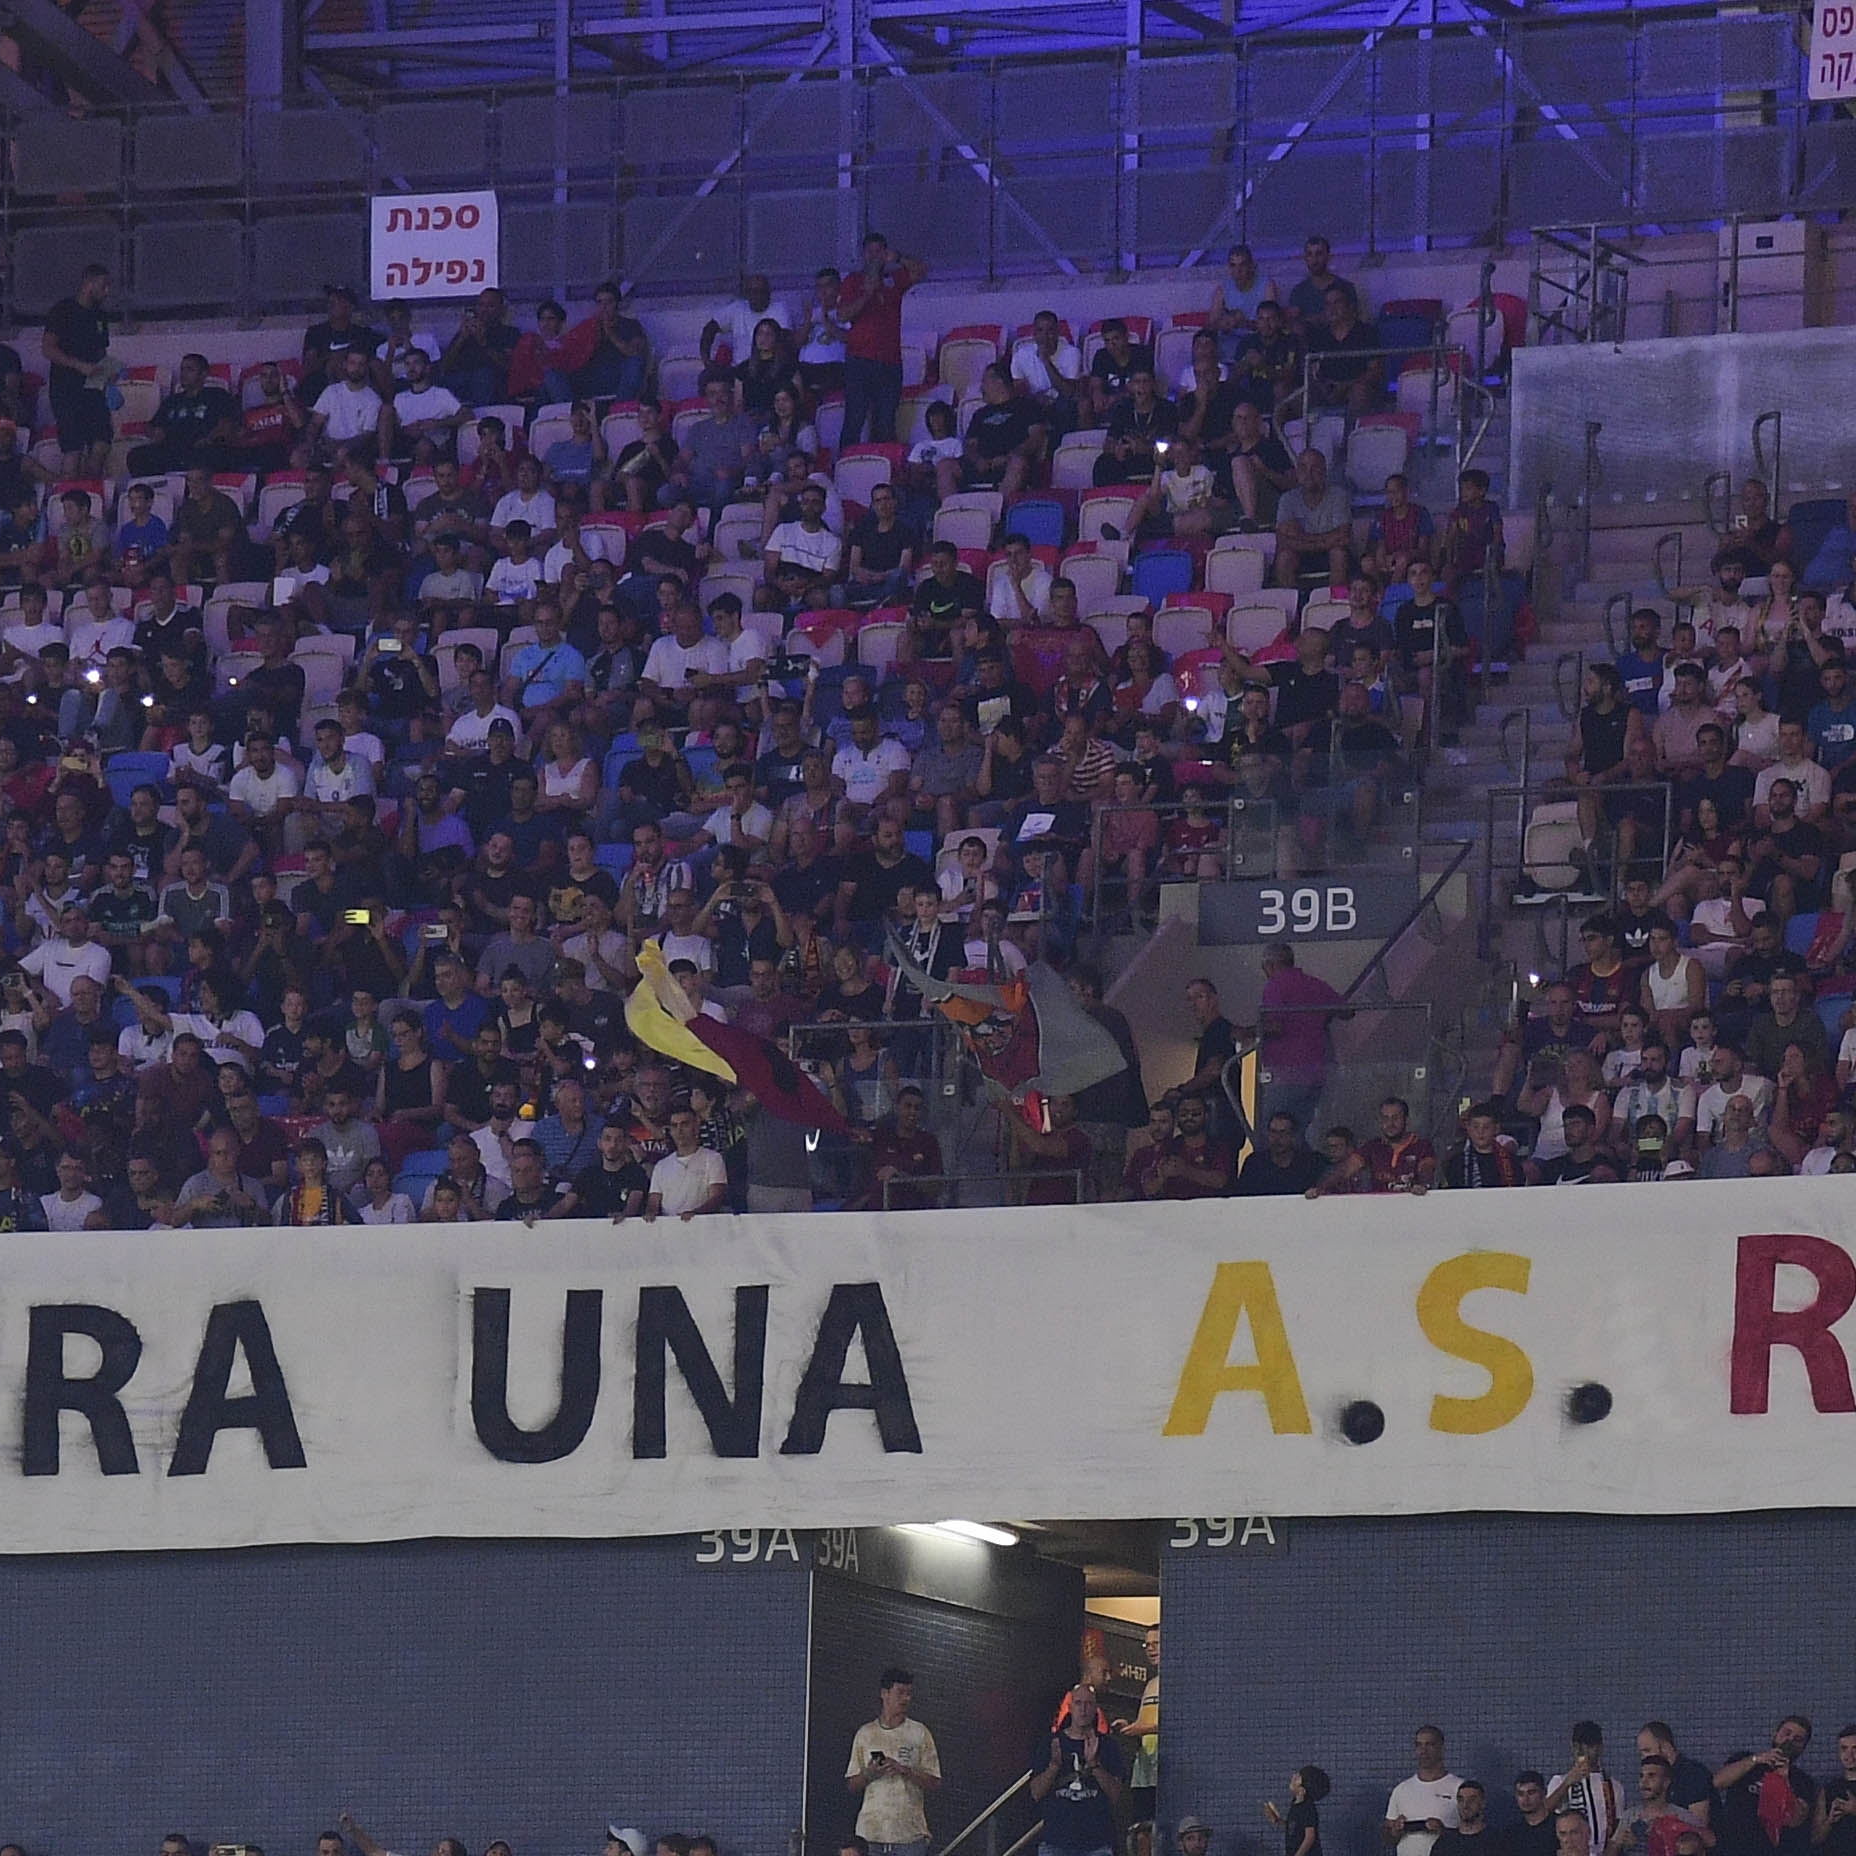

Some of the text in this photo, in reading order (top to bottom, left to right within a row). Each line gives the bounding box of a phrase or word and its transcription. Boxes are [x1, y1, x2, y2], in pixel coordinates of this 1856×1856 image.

[384, 205, 481, 234] סכנת
[385, 258, 485, 288] נפילה
[1257, 887, 1358, 936] 39B
[465, 1280, 923, 1466] UNA
[1160, 1250, 1614, 1444] A.S.
